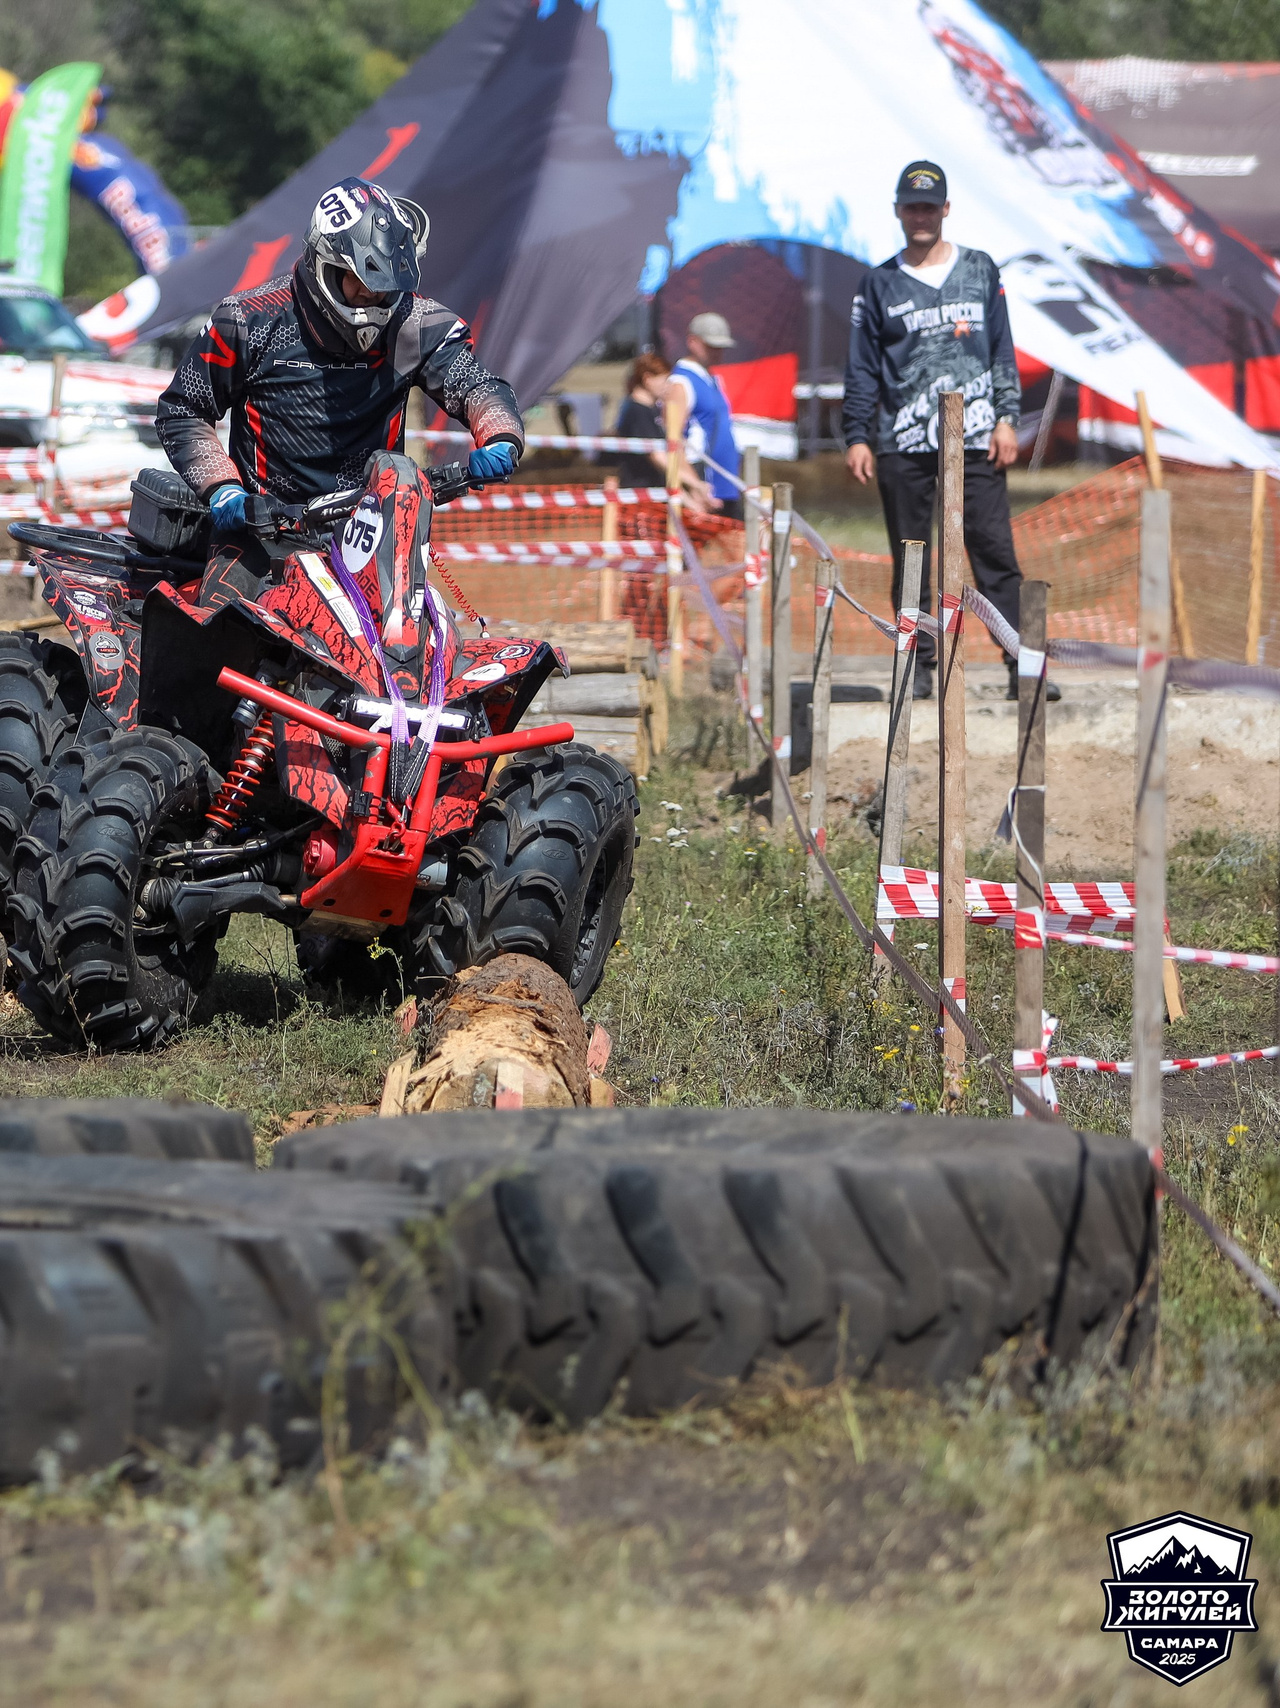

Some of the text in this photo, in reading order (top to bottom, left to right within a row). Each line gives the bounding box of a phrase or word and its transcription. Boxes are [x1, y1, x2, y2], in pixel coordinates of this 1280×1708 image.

[320, 193, 352, 228] 075
[273, 360, 368, 370] FORMULA
[344, 517, 376, 553] 075
